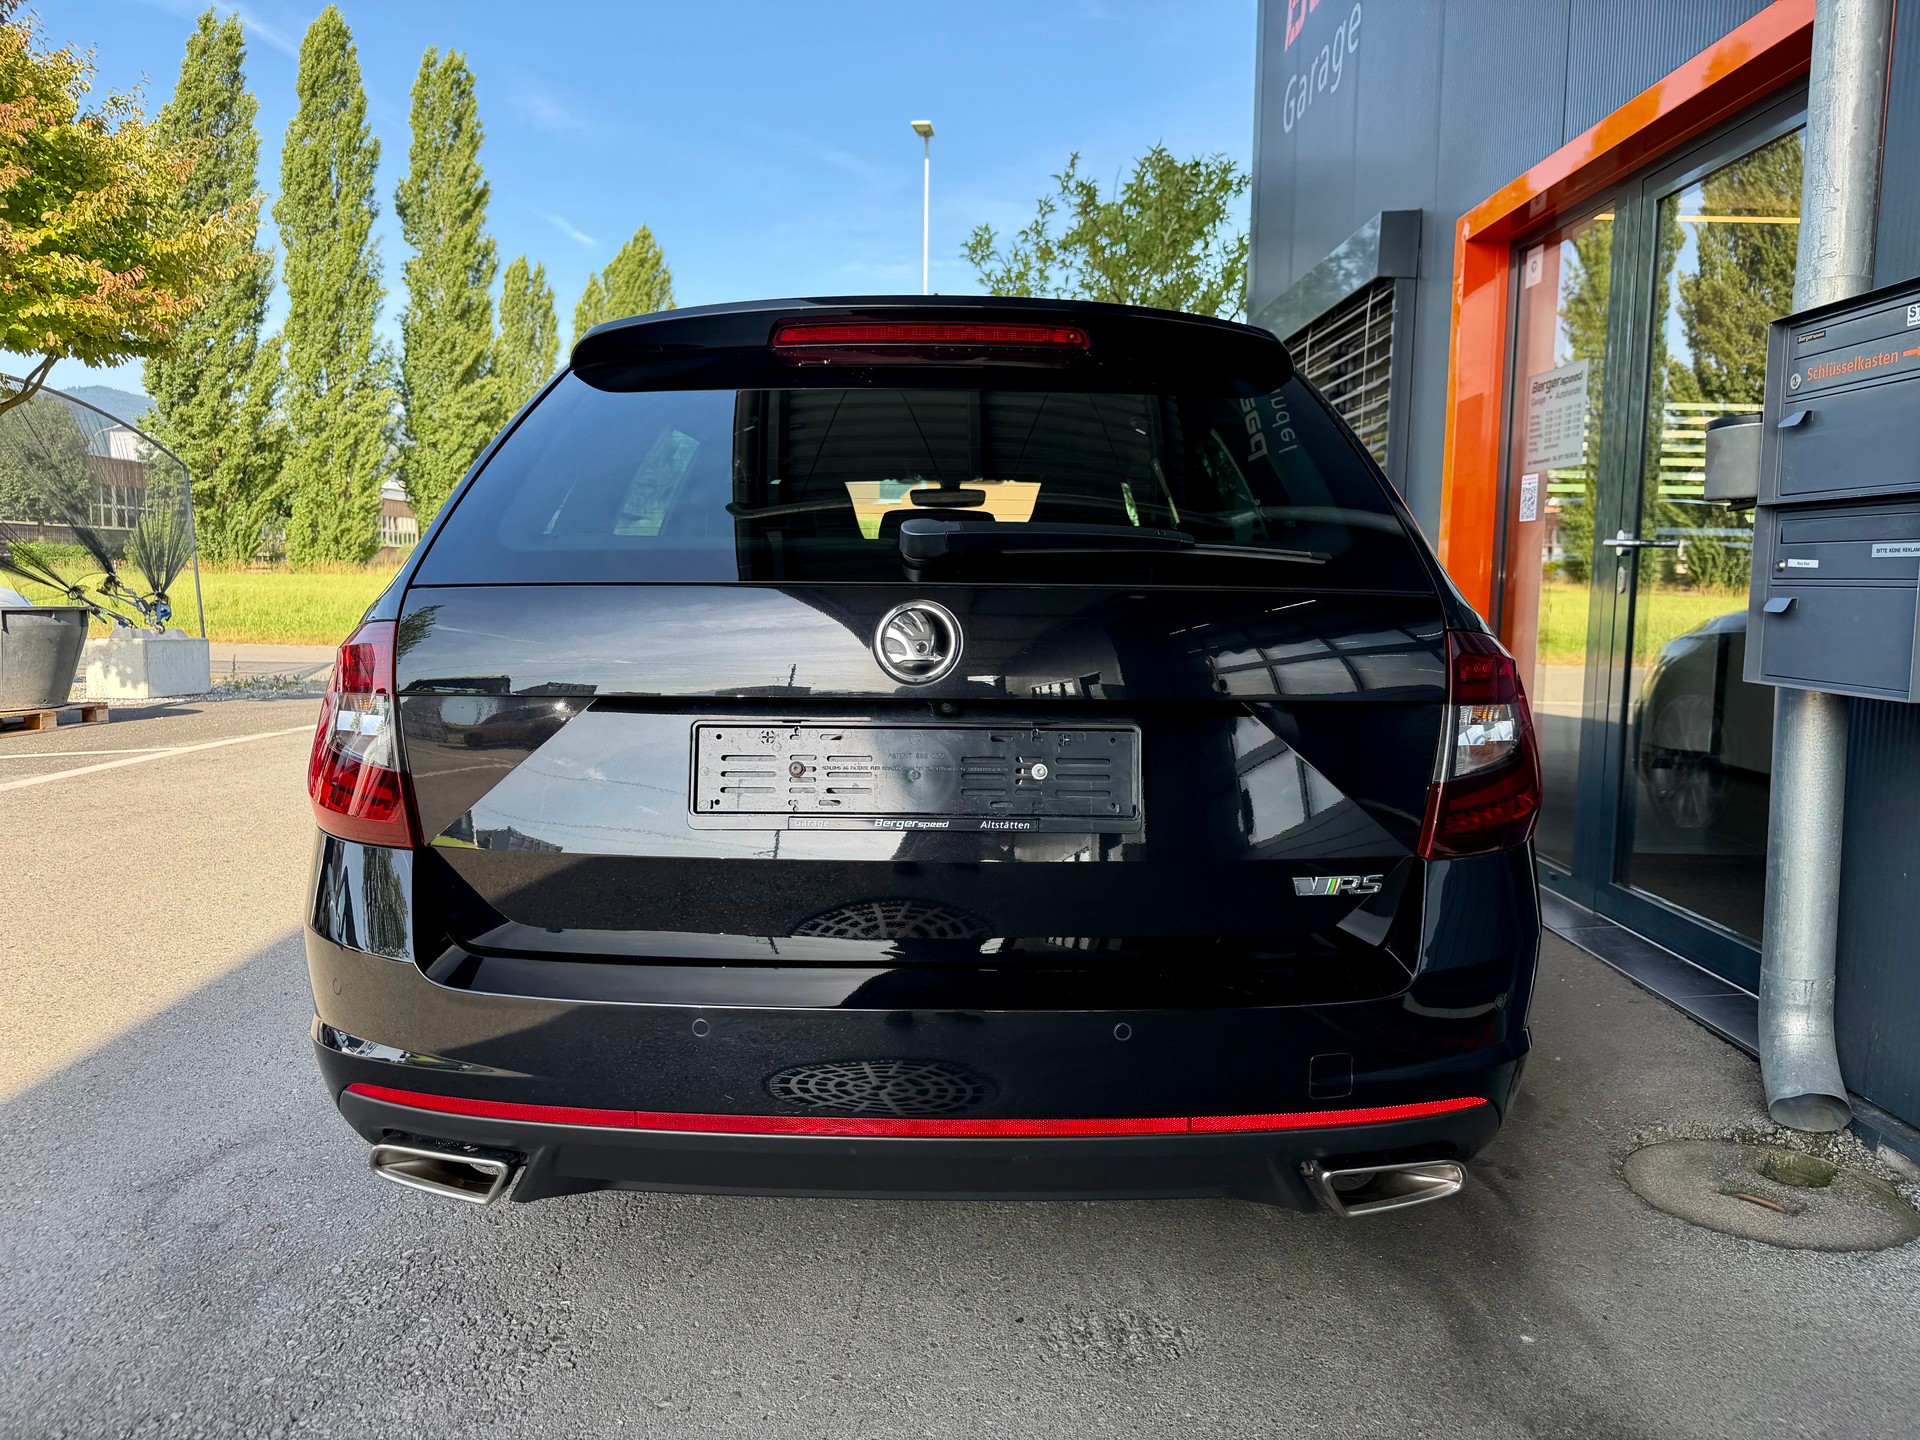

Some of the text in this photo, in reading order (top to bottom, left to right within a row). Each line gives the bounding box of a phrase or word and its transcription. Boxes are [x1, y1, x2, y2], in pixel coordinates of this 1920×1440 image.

[1285, 0, 1321, 52] B
[1283, 2, 1361, 134] Garage
[1531, 370, 1583, 394] Bergerspeed
[1807, 351, 1899, 382] Schlüsselkasten
[794, 818, 1030, 830] Garage Bergerspeed Altstätten
